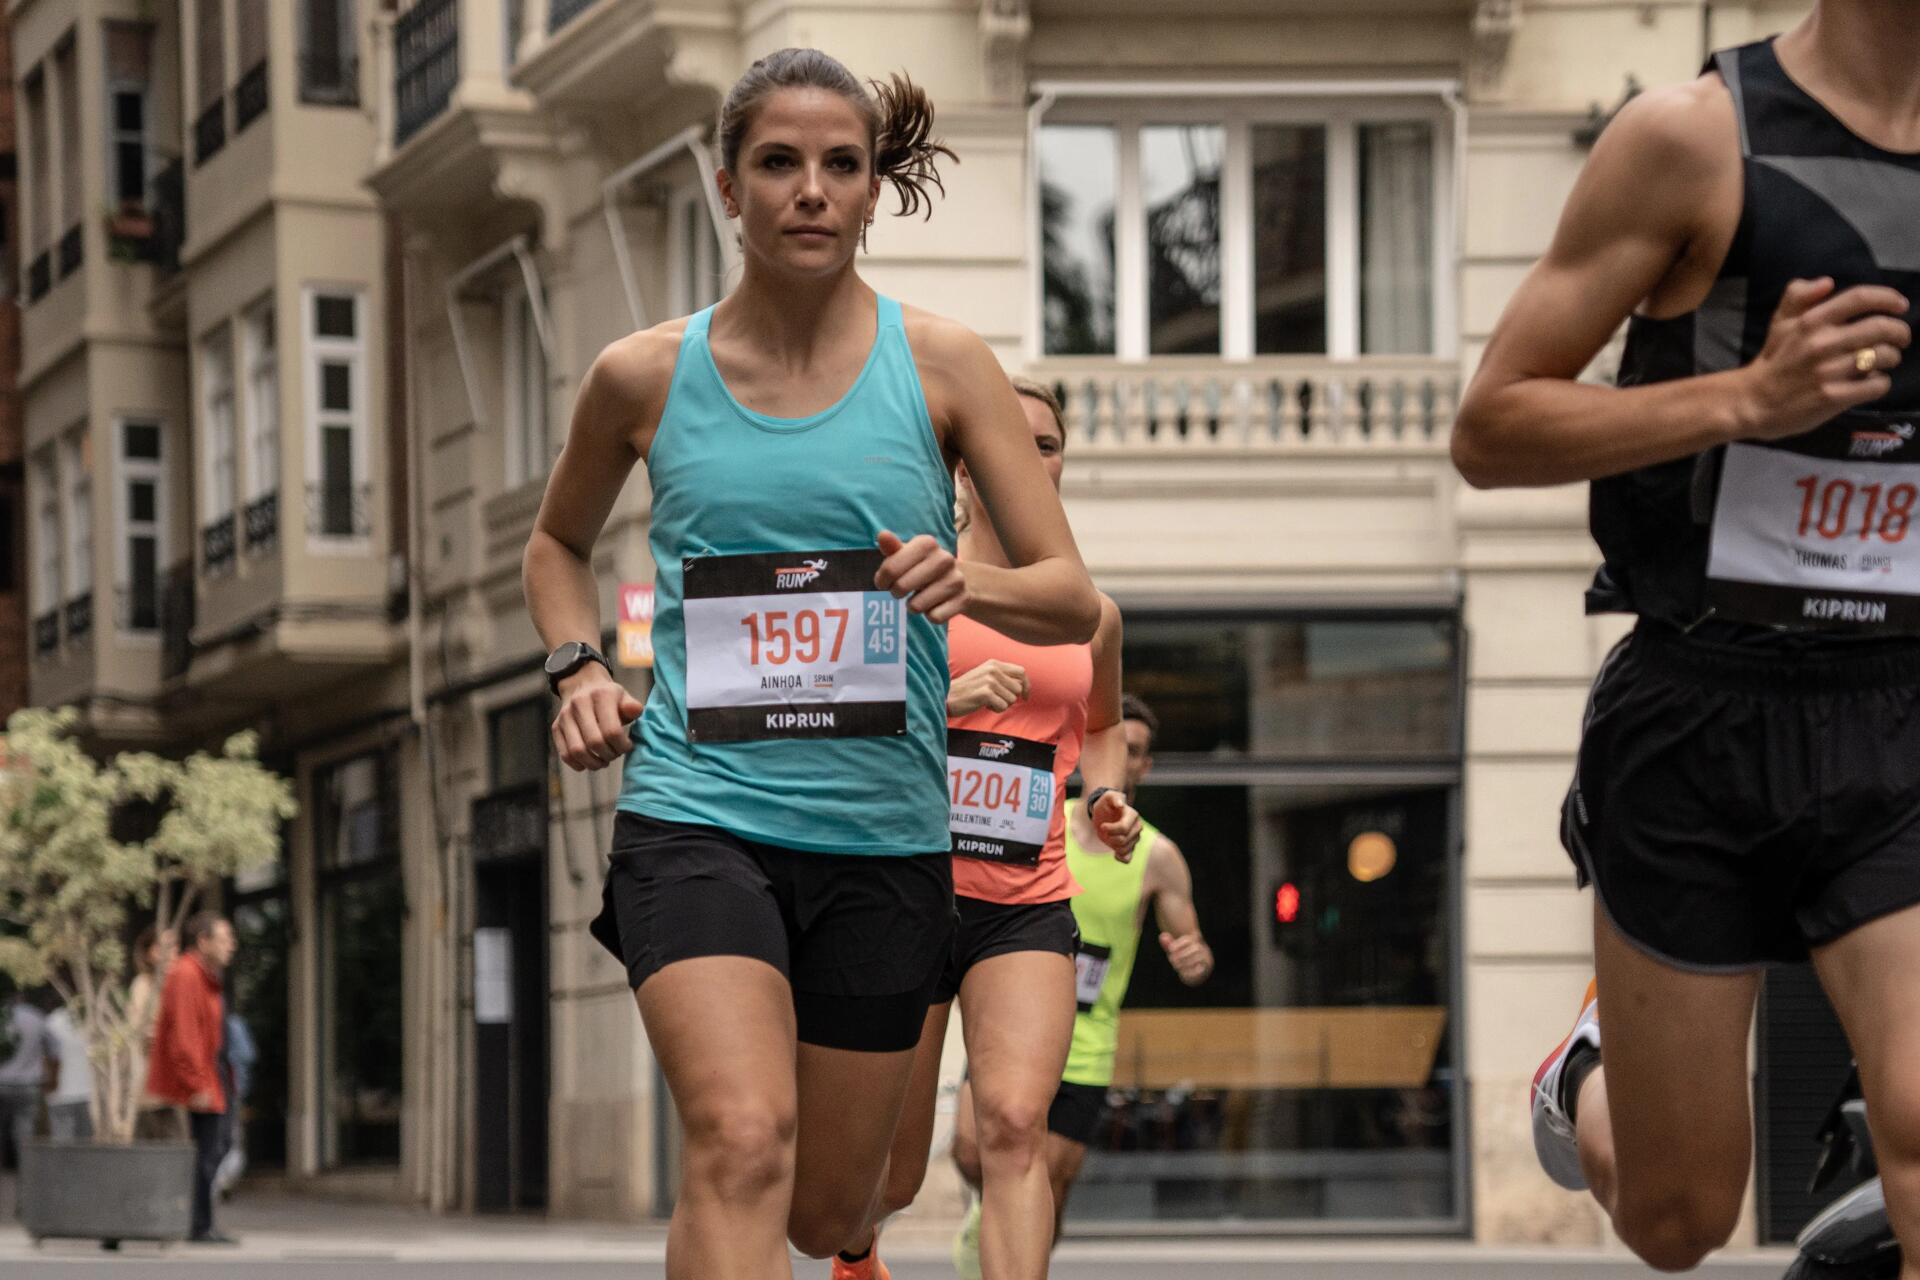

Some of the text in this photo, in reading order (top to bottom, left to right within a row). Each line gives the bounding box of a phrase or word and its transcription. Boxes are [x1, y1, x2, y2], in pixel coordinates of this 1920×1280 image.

[1795, 474, 1918, 543] 1018
[1795, 549, 1847, 571] THOMAS
[776, 573, 804, 588] RUN
[868, 600, 894, 626] 2H
[1803, 598, 1886, 622] KIPRUN
[741, 609, 849, 665] 1597
[868, 628, 894, 654] 45
[760, 674, 834, 689] AINHOA SPAIN
[766, 713, 835, 729] KIPRUN
[950, 768, 1021, 813] 1204
[1032, 774, 1049, 794] 2H
[1029, 795, 1047, 813] 30
[957, 839, 1004, 855] KIPRUN
